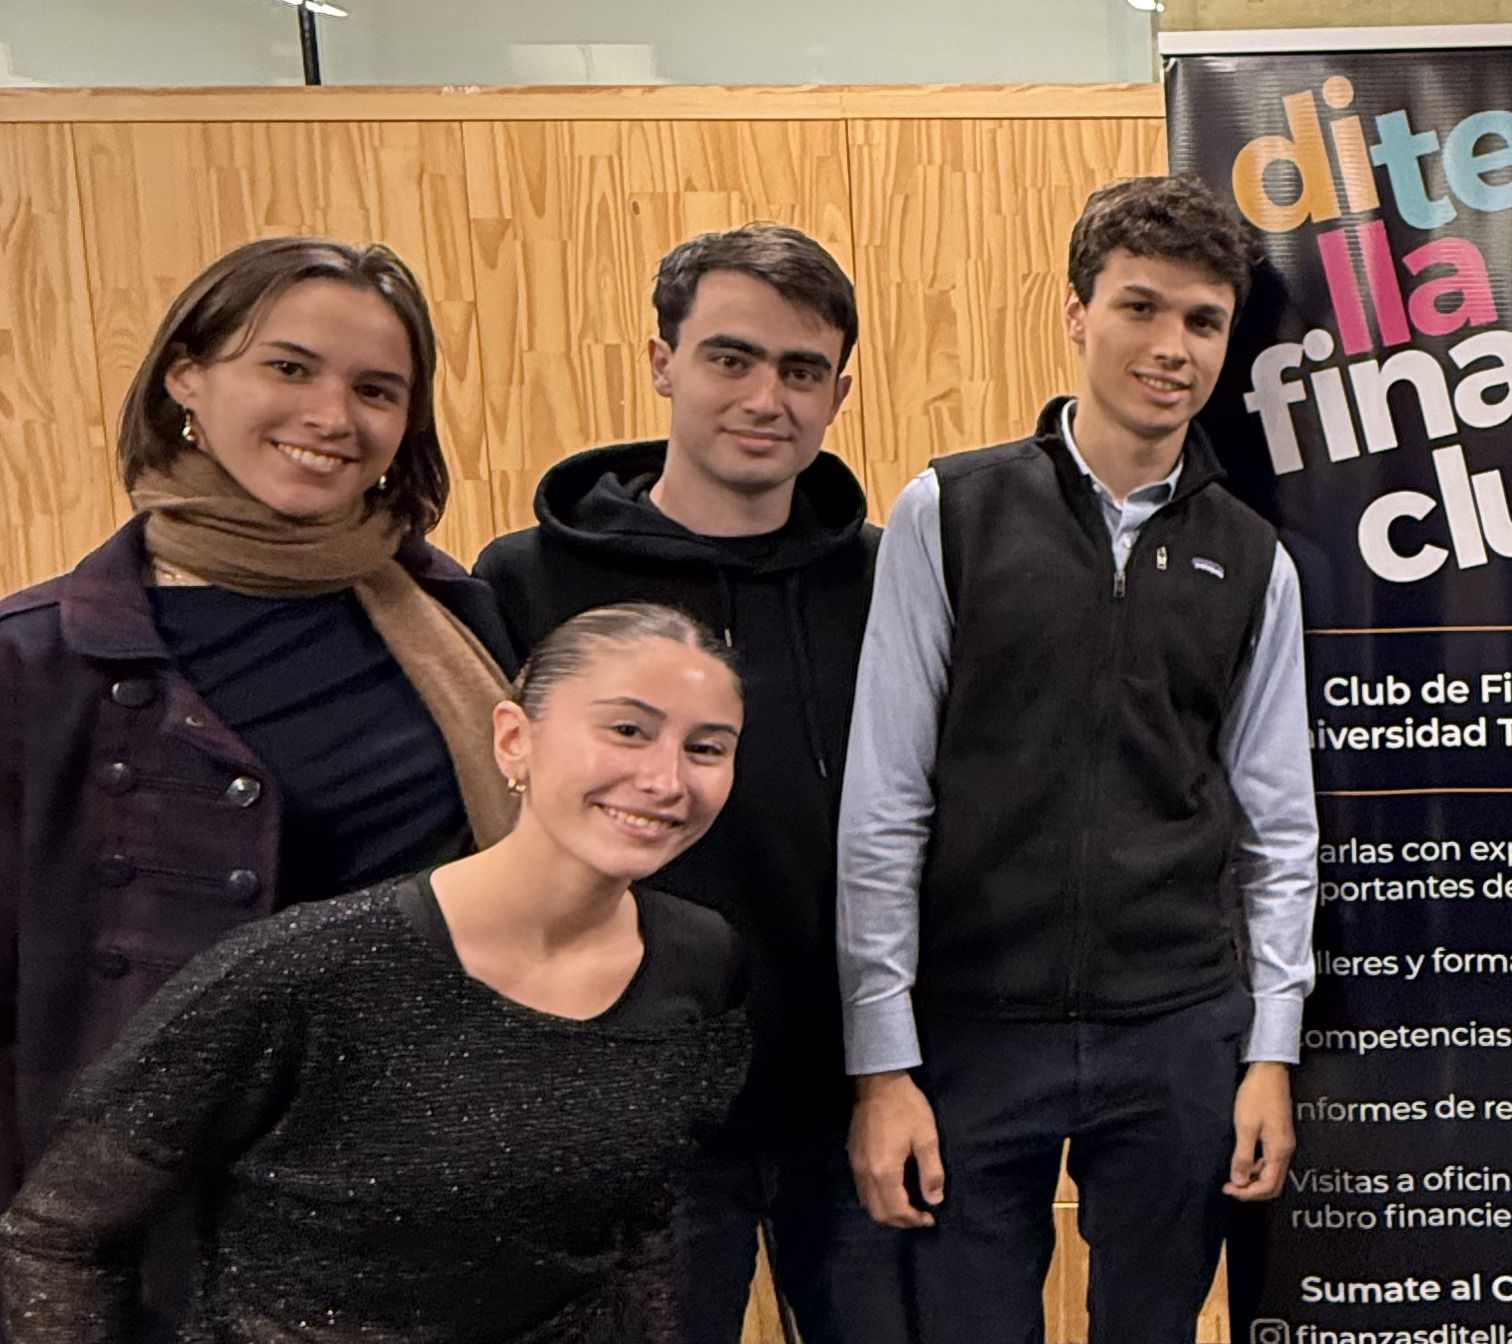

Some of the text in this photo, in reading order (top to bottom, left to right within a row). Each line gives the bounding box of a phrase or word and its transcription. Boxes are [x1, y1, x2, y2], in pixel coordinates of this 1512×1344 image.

[1317, 219, 1498, 355] lla
[1324, 675, 1411, 706] Club
[1421, 674, 1469, 703] de
[1309, 717, 1486, 749] iversidad
[1321, 838, 1393, 863] arlas
[1402, 841, 1460, 862] con
[1321, 876, 1474, 907] portantes
[1317, 951, 1399, 975] lleres
[1405, 955, 1424, 980] y
[1301, 1022, 1512, 1055] ompetencias
[1298, 1097, 1427, 1122] nformes
[1435, 1094, 1475, 1119] de
[1289, 1168, 1389, 1193] Visitas
[1397, 1174, 1414, 1192] a
[1292, 1204, 1376, 1229] rubro
[1302, 1276, 1441, 1303] Sumate
[1451, 1274, 1480, 1300] al
